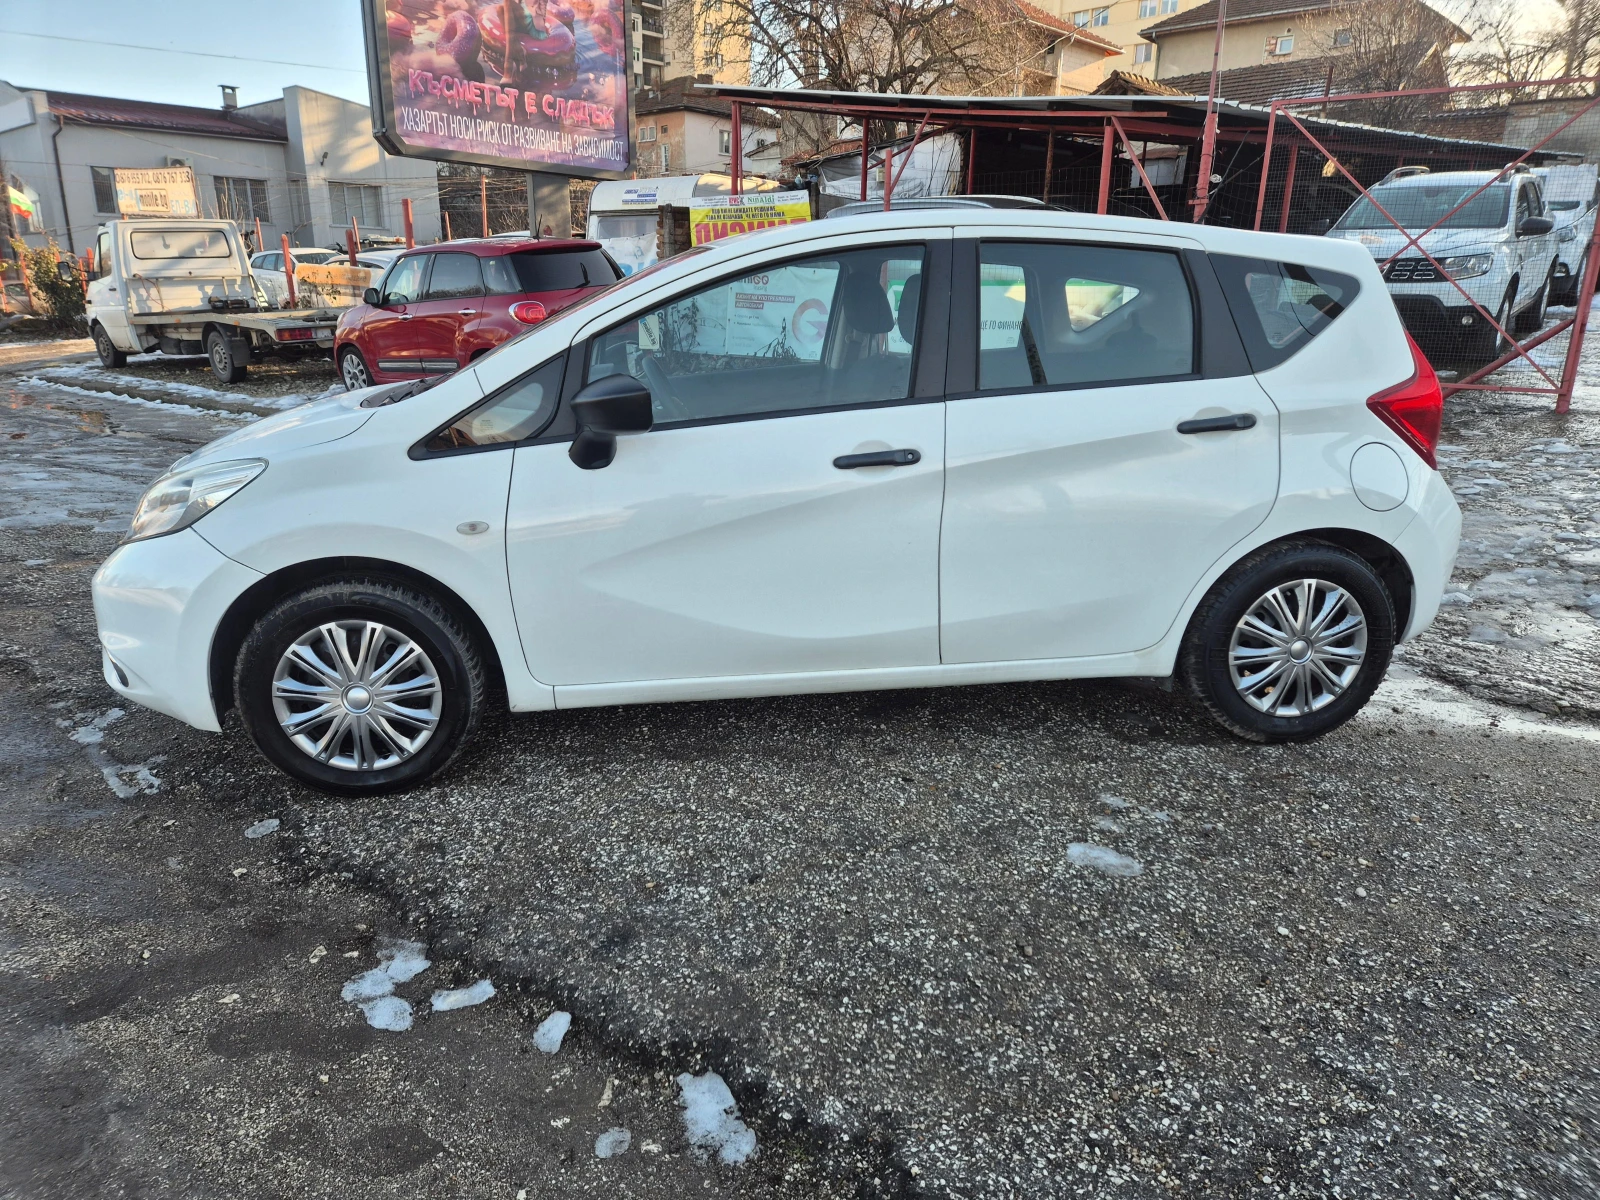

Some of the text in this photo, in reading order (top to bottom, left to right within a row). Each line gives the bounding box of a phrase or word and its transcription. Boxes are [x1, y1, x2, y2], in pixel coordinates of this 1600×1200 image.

[408, 68, 615, 127] КЪСМЕТЪТ Е СЛАДЪК
[401, 106, 624, 161] ХАЗАРТЪТ НОСИ РИСК ОТ РАЗВИВАНЕ НА ЗАВИСИМОСТ
[989, 320, 996, 330] ГО
